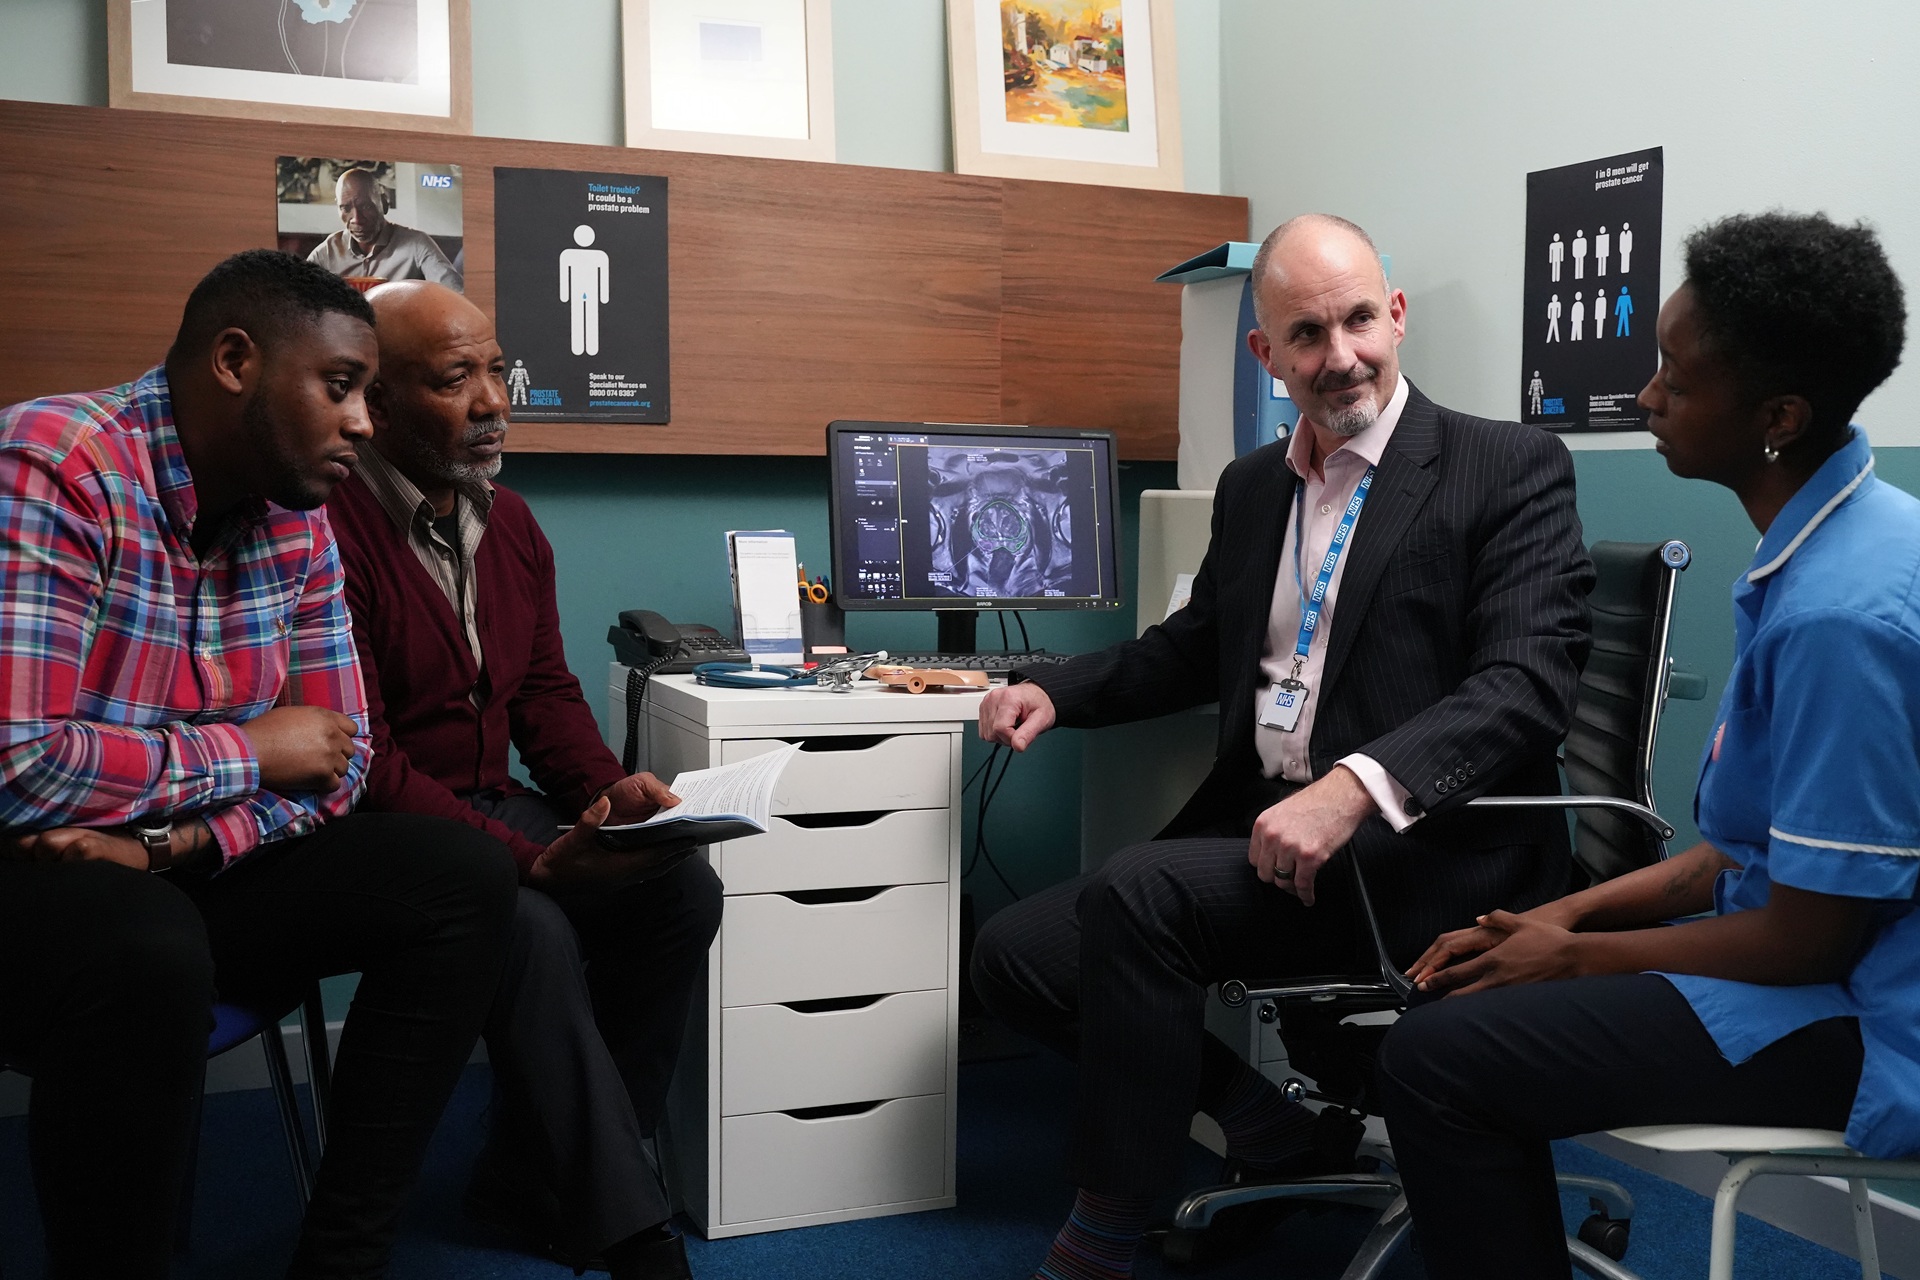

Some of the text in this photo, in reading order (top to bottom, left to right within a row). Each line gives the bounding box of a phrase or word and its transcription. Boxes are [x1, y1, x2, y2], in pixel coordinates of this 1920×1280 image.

[1599, 170, 1606, 178] in
[1606, 168, 1612, 178] 8
[1612, 167, 1626, 176] men
[1626, 162, 1638, 174] will
[1638, 162, 1649, 174] get
[422, 175, 451, 188] NHS
[588, 183, 640, 194] Toilet trouble?
[1595, 174, 1644, 192] prostate cancer
[588, 192, 594, 201] It
[595, 194, 616, 202] could
[616, 194, 626, 203] be
[588, 204, 650, 214] prostate problem
[589, 372, 607, 380] Speak
[1362, 470, 1375, 490] NHS
[1348, 496, 1362, 516] NHS
[1334, 524, 1348, 544] NHS
[1323, 552, 1336, 572] NHS
[1313, 582, 1325, 602] NHS
[1304, 611, 1316, 631] NHS
[1276, 693, 1295, 706] NHS
